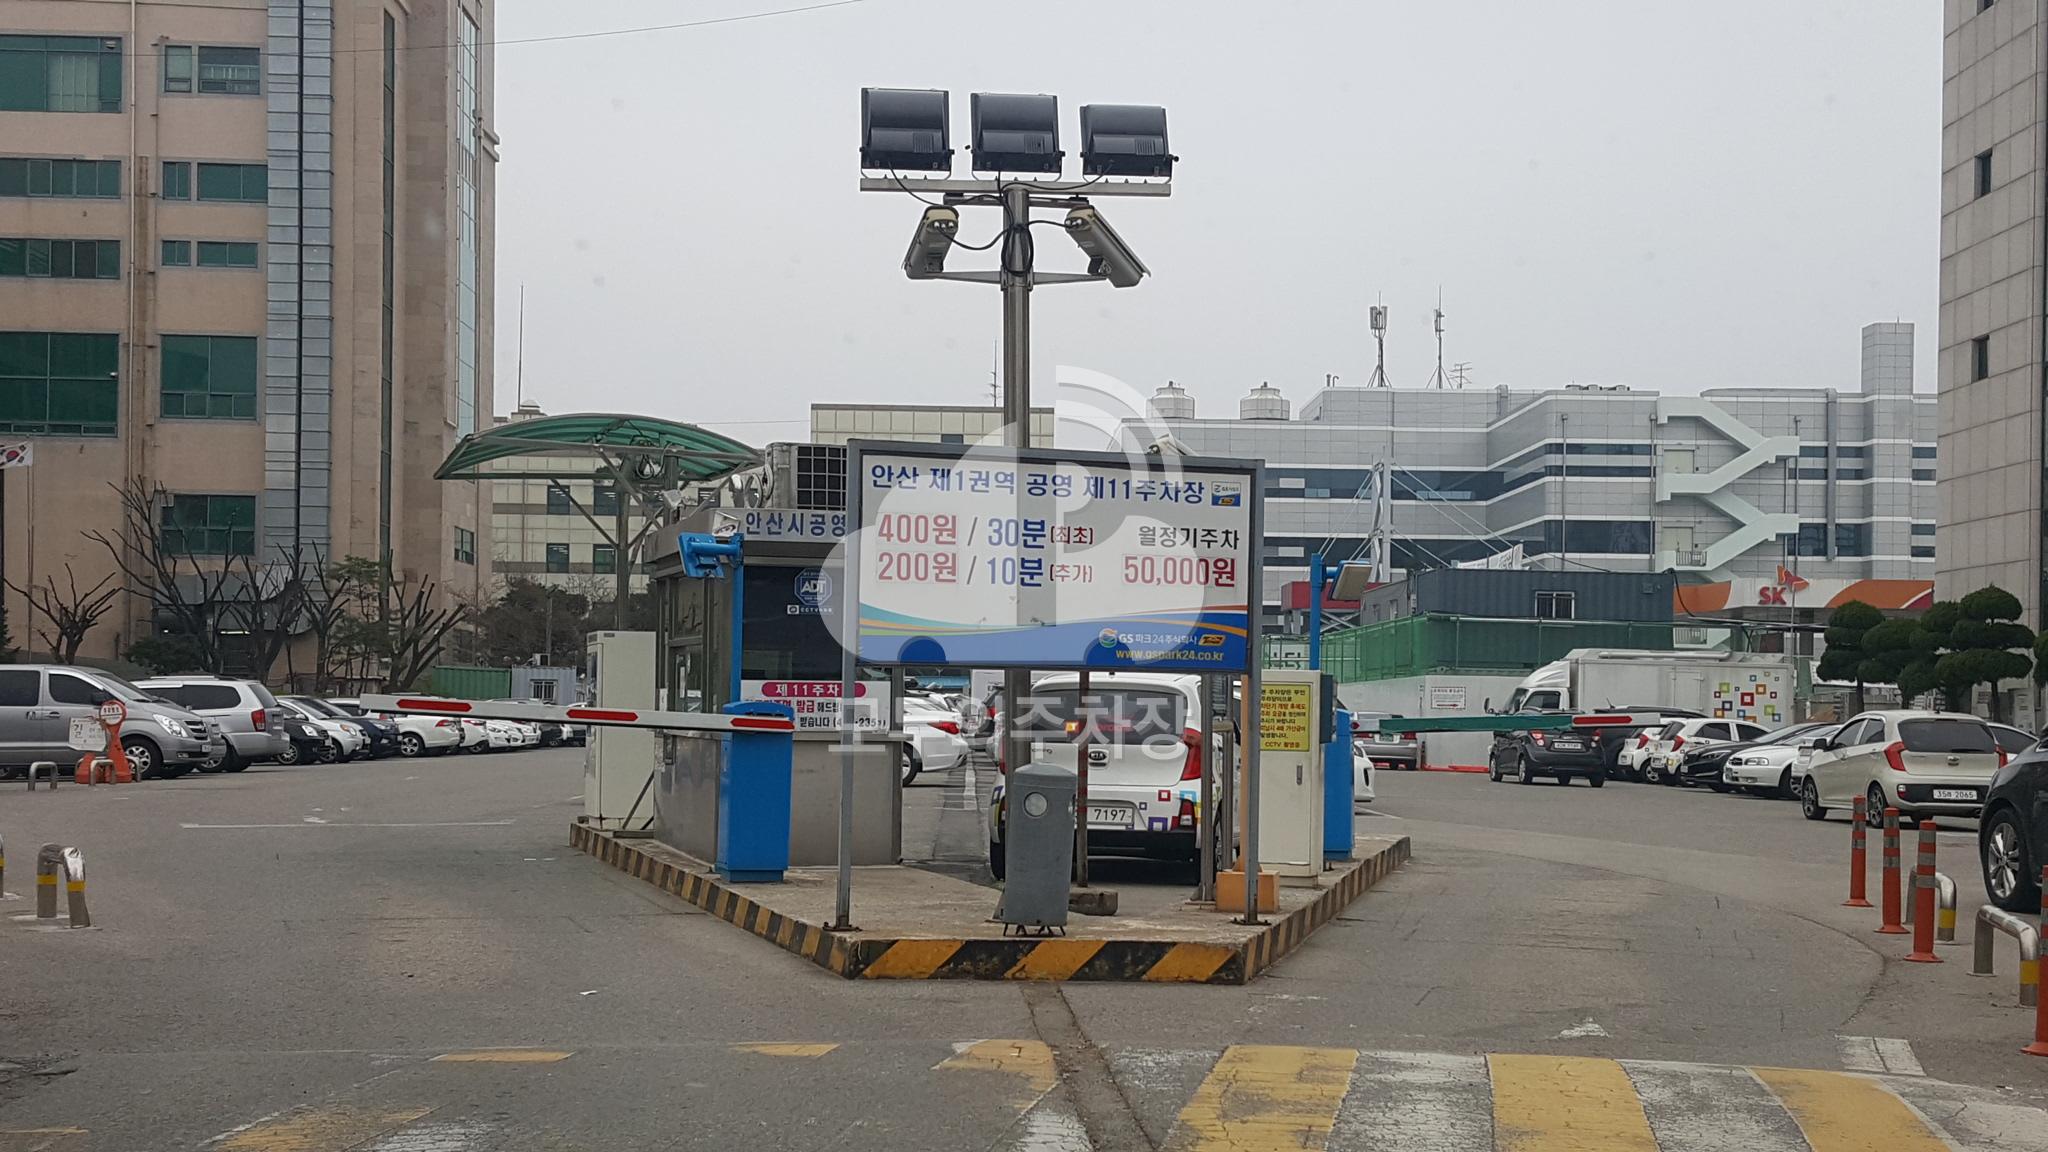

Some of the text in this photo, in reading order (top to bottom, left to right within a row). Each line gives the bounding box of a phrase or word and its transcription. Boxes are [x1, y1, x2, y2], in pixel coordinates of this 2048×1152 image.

[871, 464, 1205, 504] 안산 제1권역 공영 제11주차장
[877, 513, 957, 546] 400원
[987, 517, 1047, 550] 30분
[1138, 525, 1240, 551] 월정기주차
[877, 551, 957, 584] 200원
[986, 556, 1045, 588] 10분
[1123, 555, 1236, 588] 50,000원
[800, 580, 827, 593] ADT
[1758, 586, 1787, 605] SK
[1115, 649, 1225, 662] www.gspark24.co.kr
[775, 683, 841, 698] 제11주차
[796, 699, 815, 714] 발급
[1094, 808, 1127, 821] 7197
